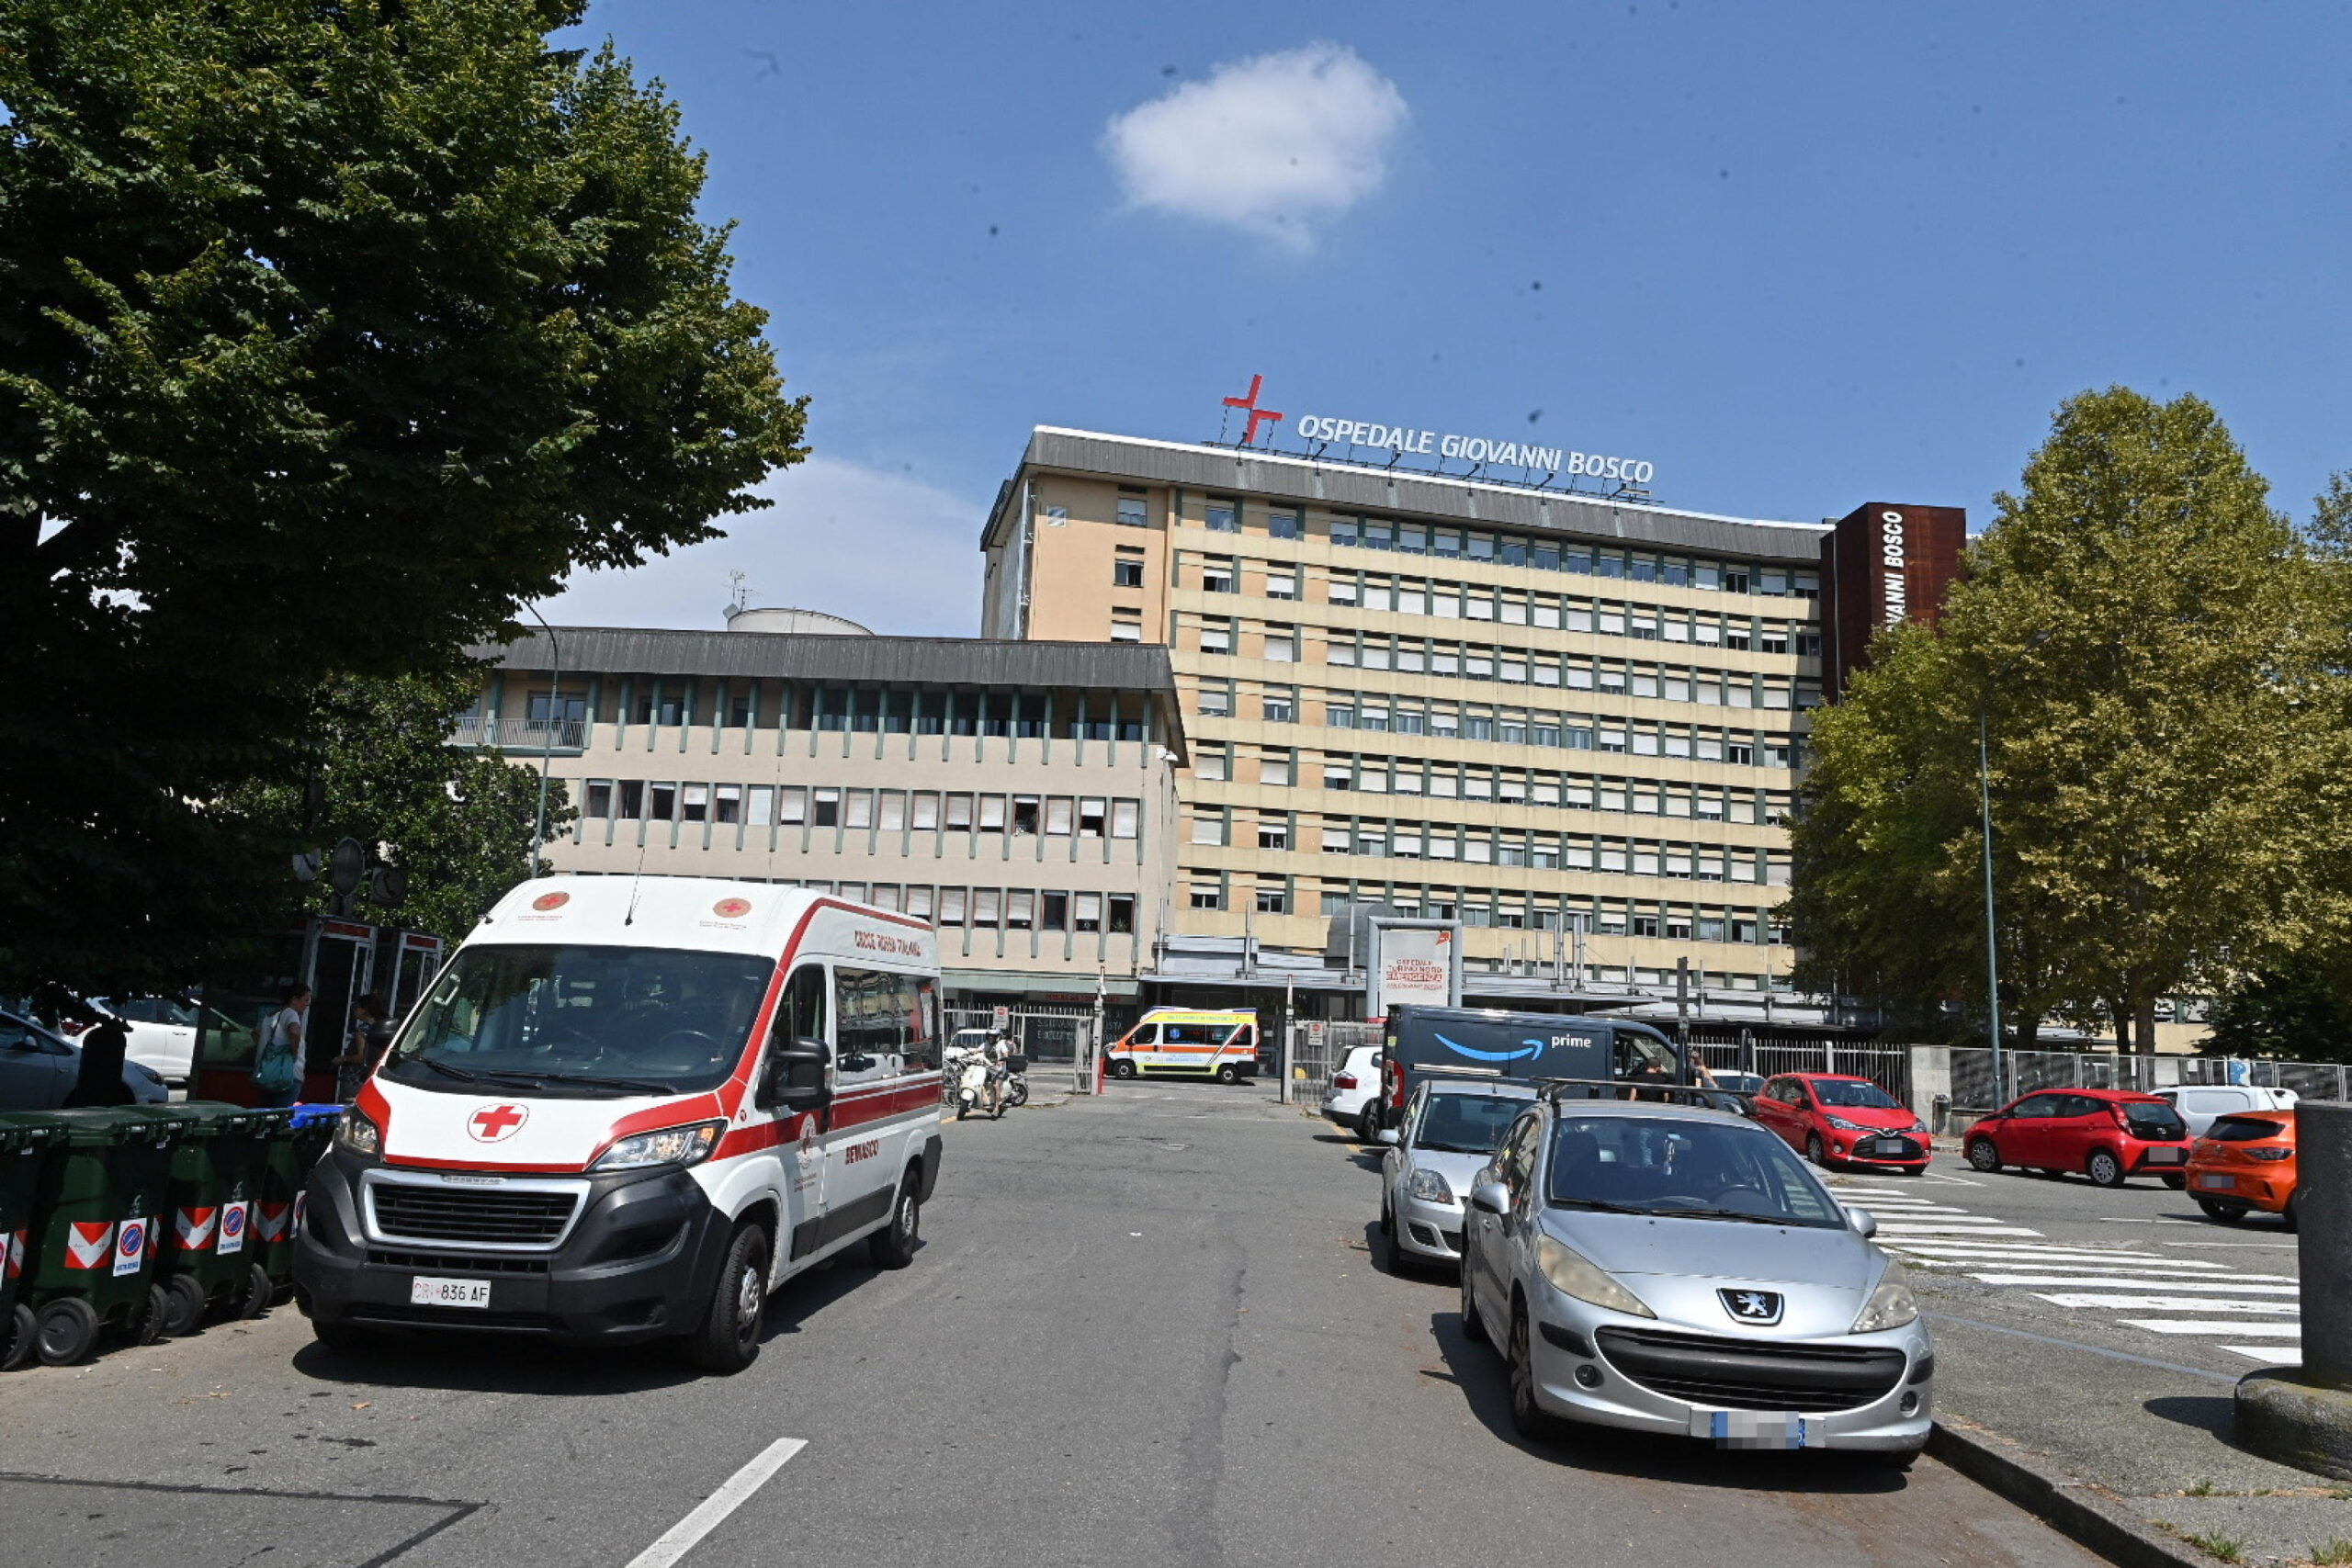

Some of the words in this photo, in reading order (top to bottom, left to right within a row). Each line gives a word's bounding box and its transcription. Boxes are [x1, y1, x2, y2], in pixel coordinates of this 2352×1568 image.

[1297, 414, 1435, 454] OSPEDALE
[1441, 434, 1562, 471] GIOVANNI
[1567, 451, 1654, 483] BOSCO
[1882, 510, 1905, 569] BOSCO
[1551, 1032, 1592, 1049] prime
[441, 1284, 467, 1301] 836
[470, 1285, 489, 1302] AF
